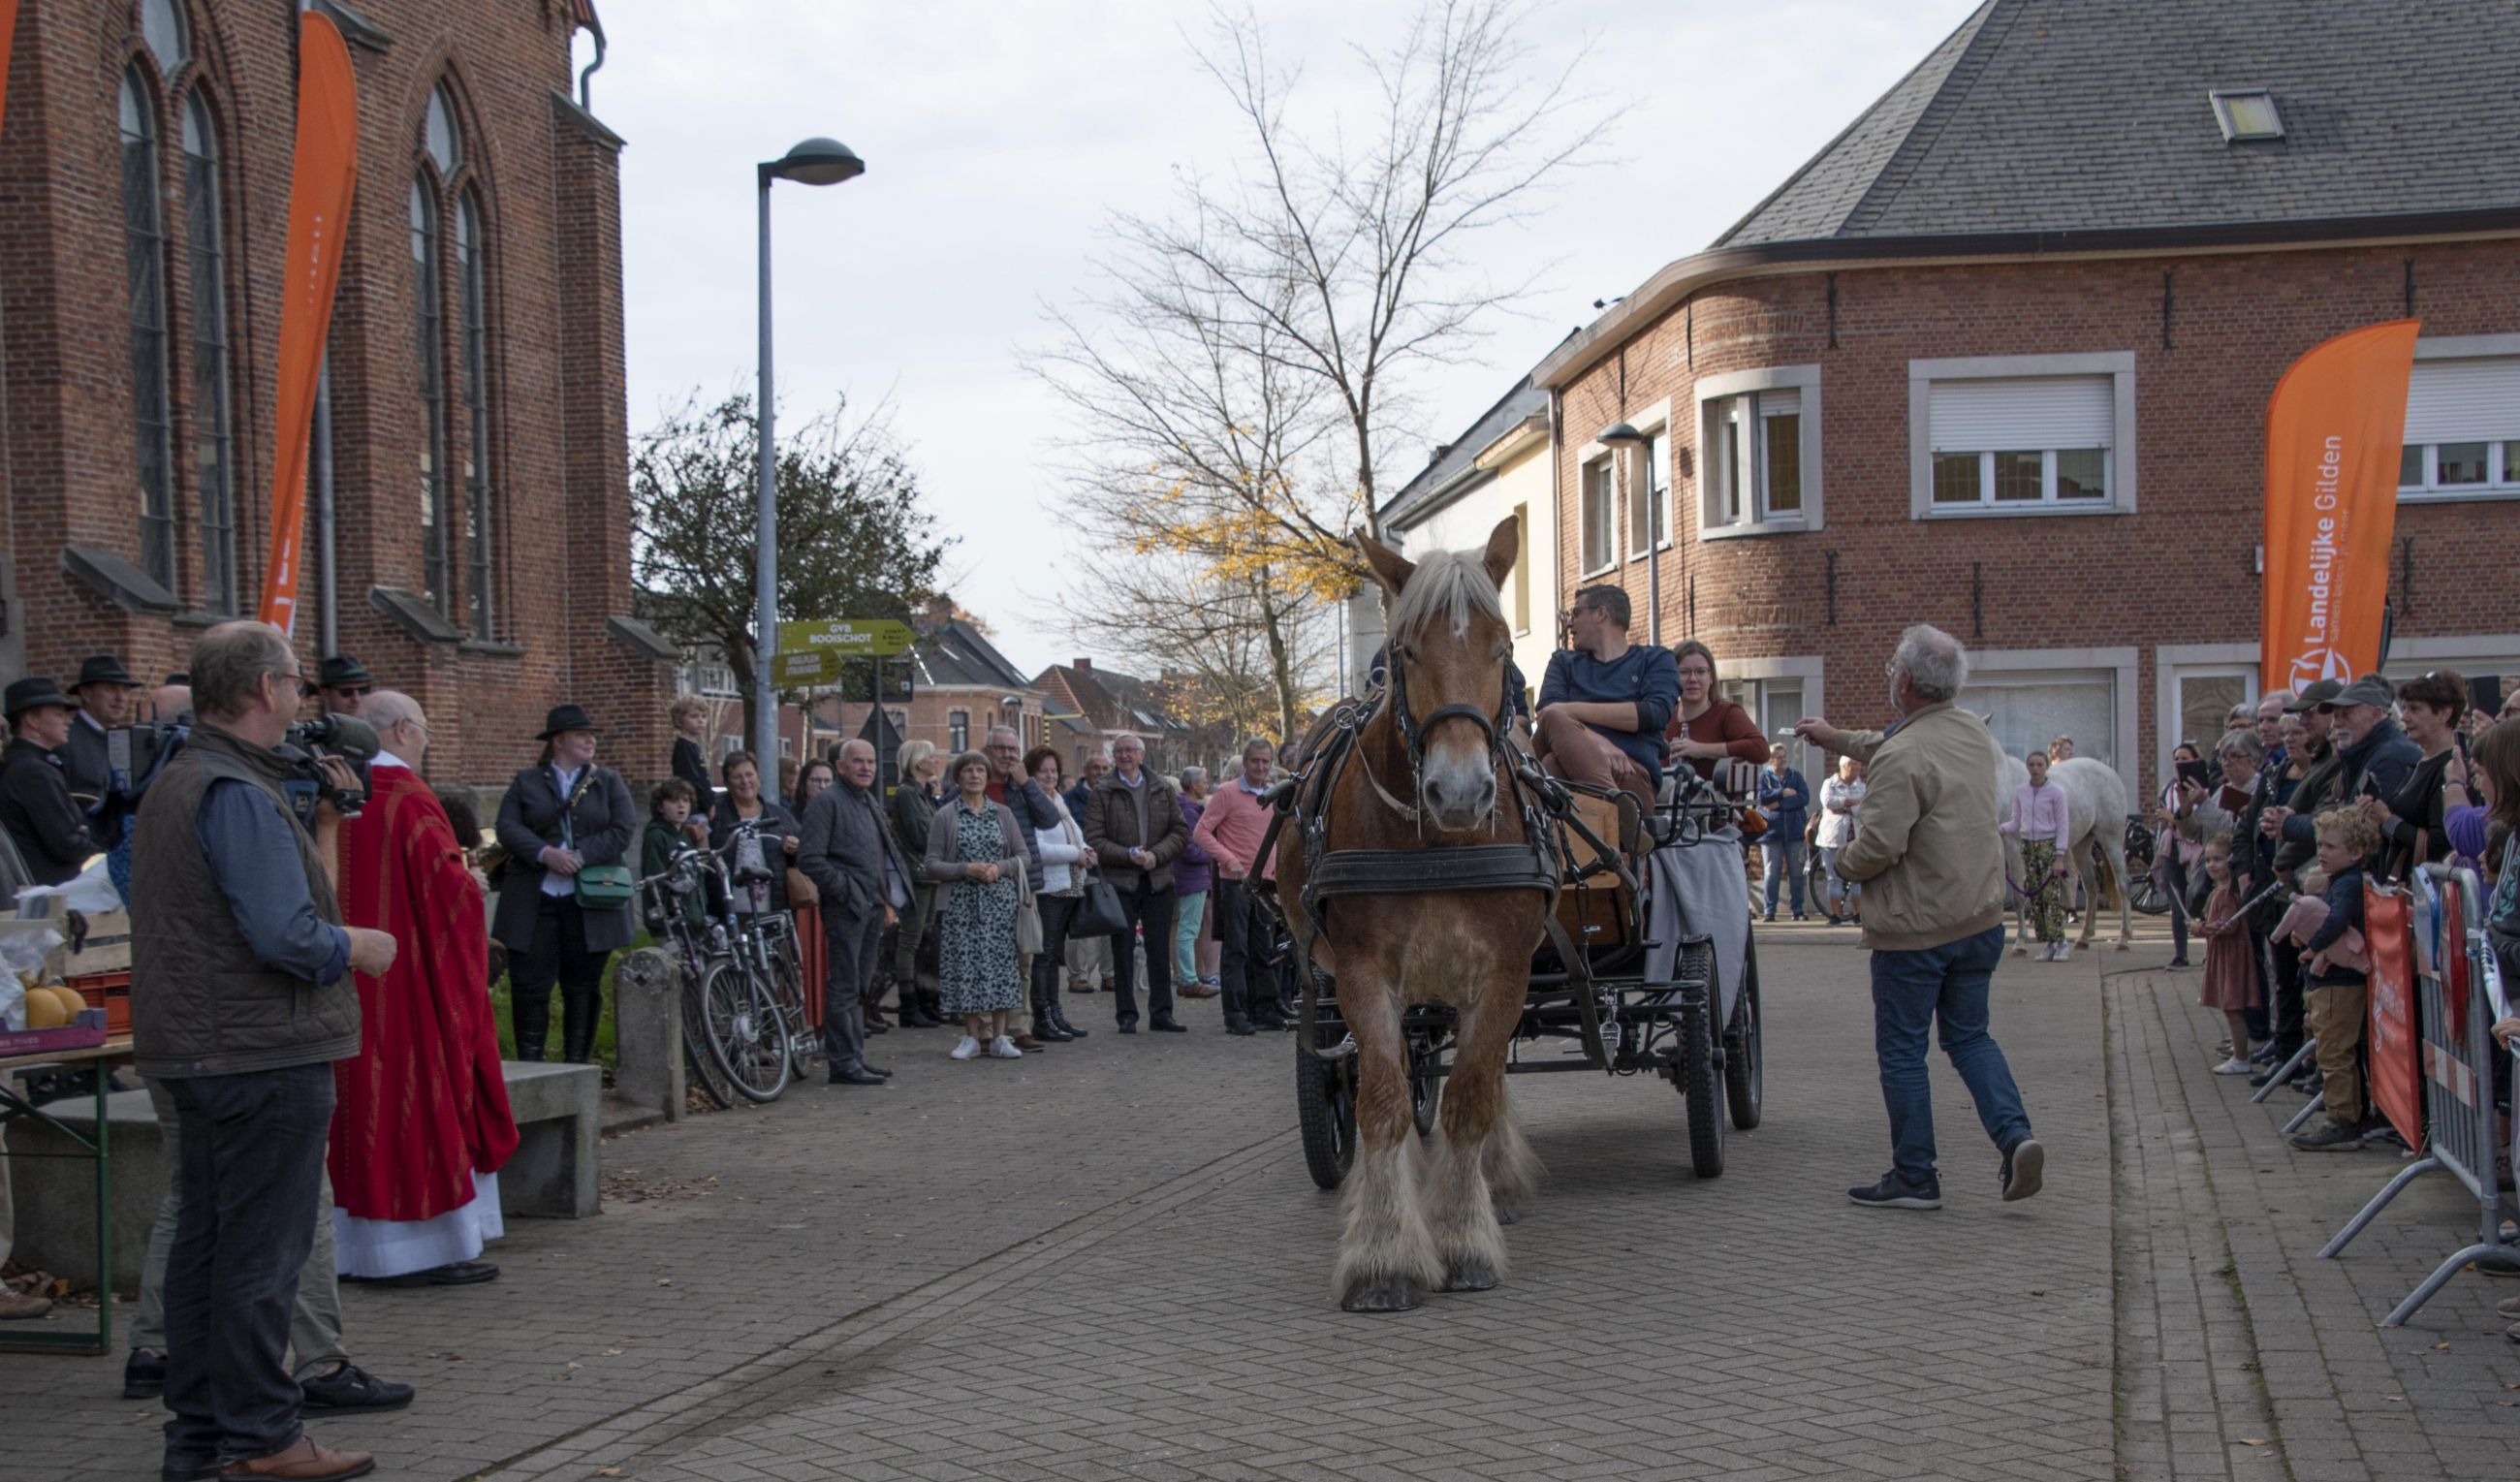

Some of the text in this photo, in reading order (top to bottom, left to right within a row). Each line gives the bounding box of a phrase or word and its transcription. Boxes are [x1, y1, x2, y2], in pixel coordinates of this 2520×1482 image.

[2304, 435, 2342, 644] Landelijke Gilden
[808, 633, 872, 644] BOOISCHOT
